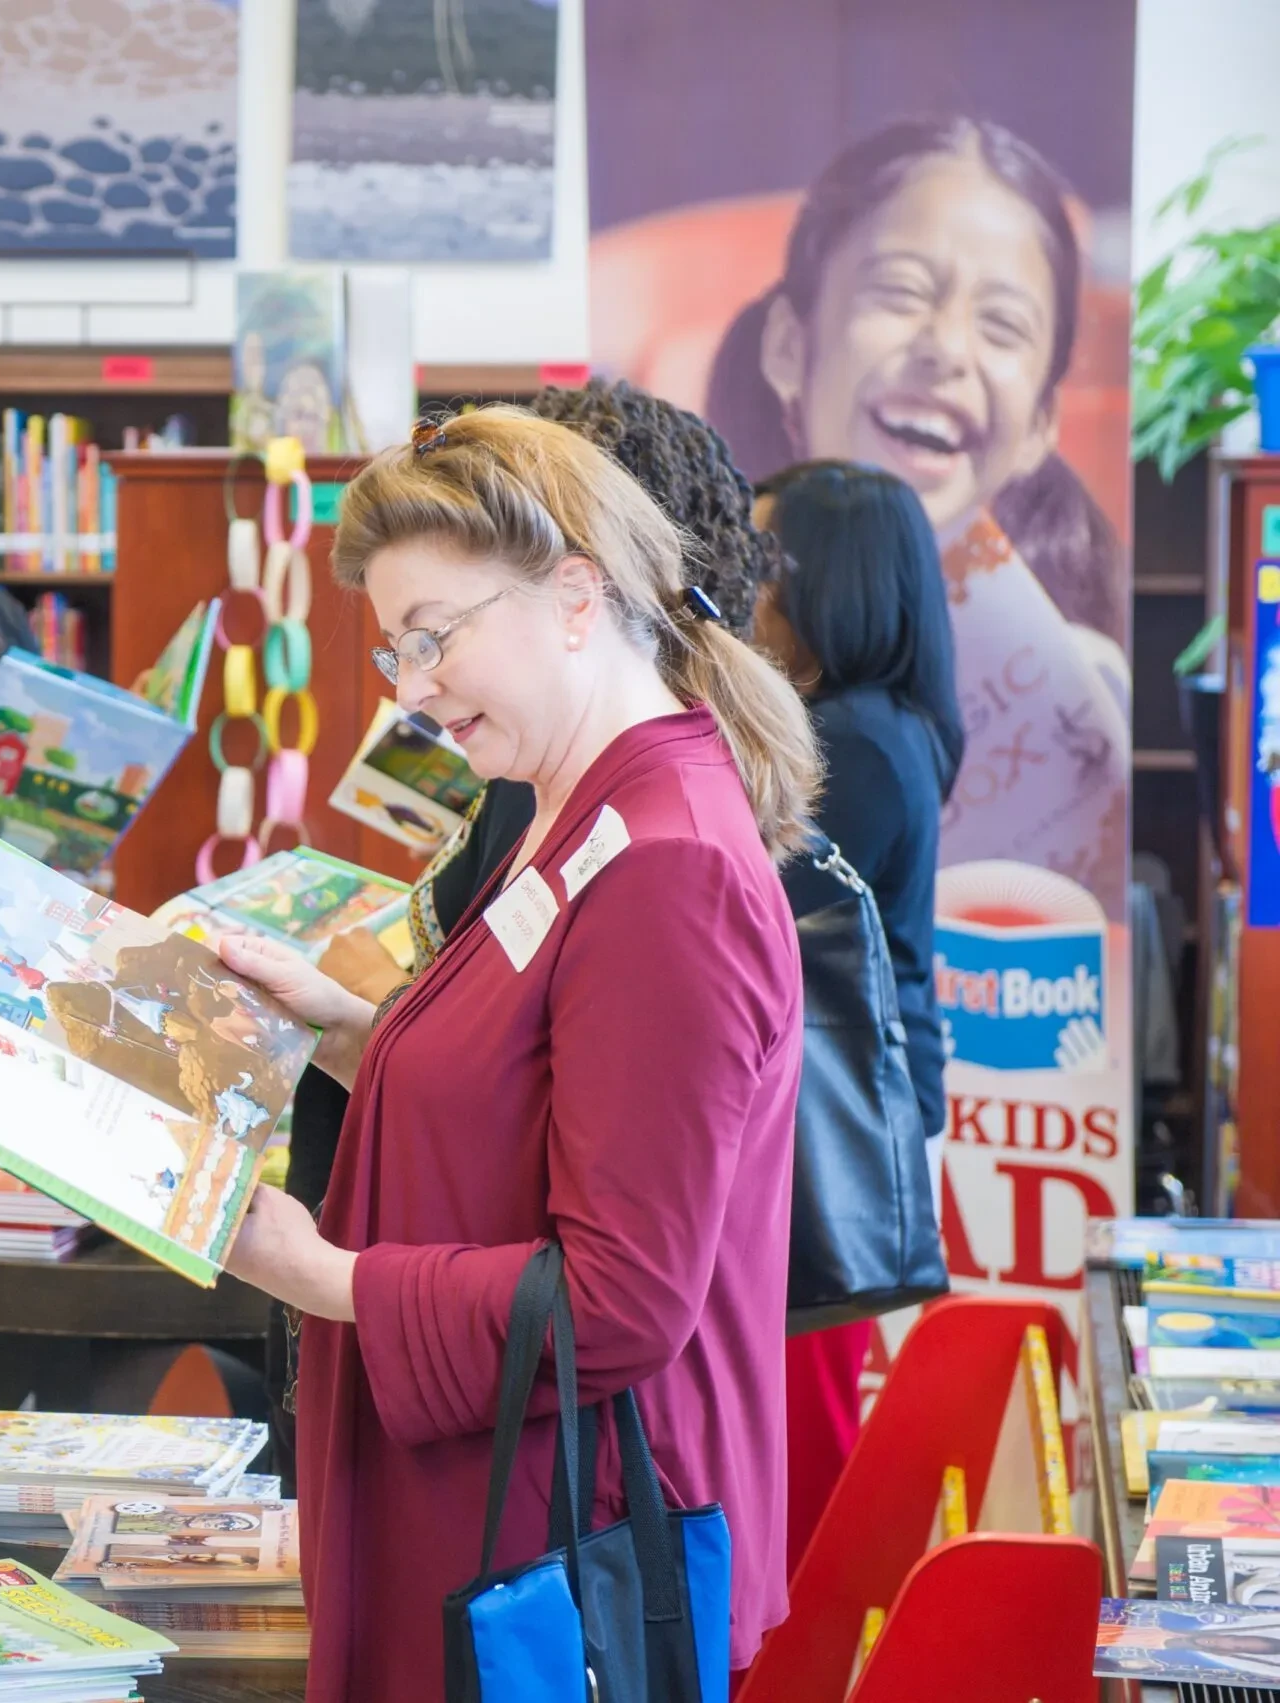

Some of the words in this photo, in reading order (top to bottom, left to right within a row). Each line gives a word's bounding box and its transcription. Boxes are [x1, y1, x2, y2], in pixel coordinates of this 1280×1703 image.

[934, 958, 999, 1018] irst
[948, 1093, 1119, 1160] KIDS
[940, 1158, 1118, 1291] AD
[1186, 1544, 1216, 1573] Urban
[1189, 1575, 1218, 1604] Anim
